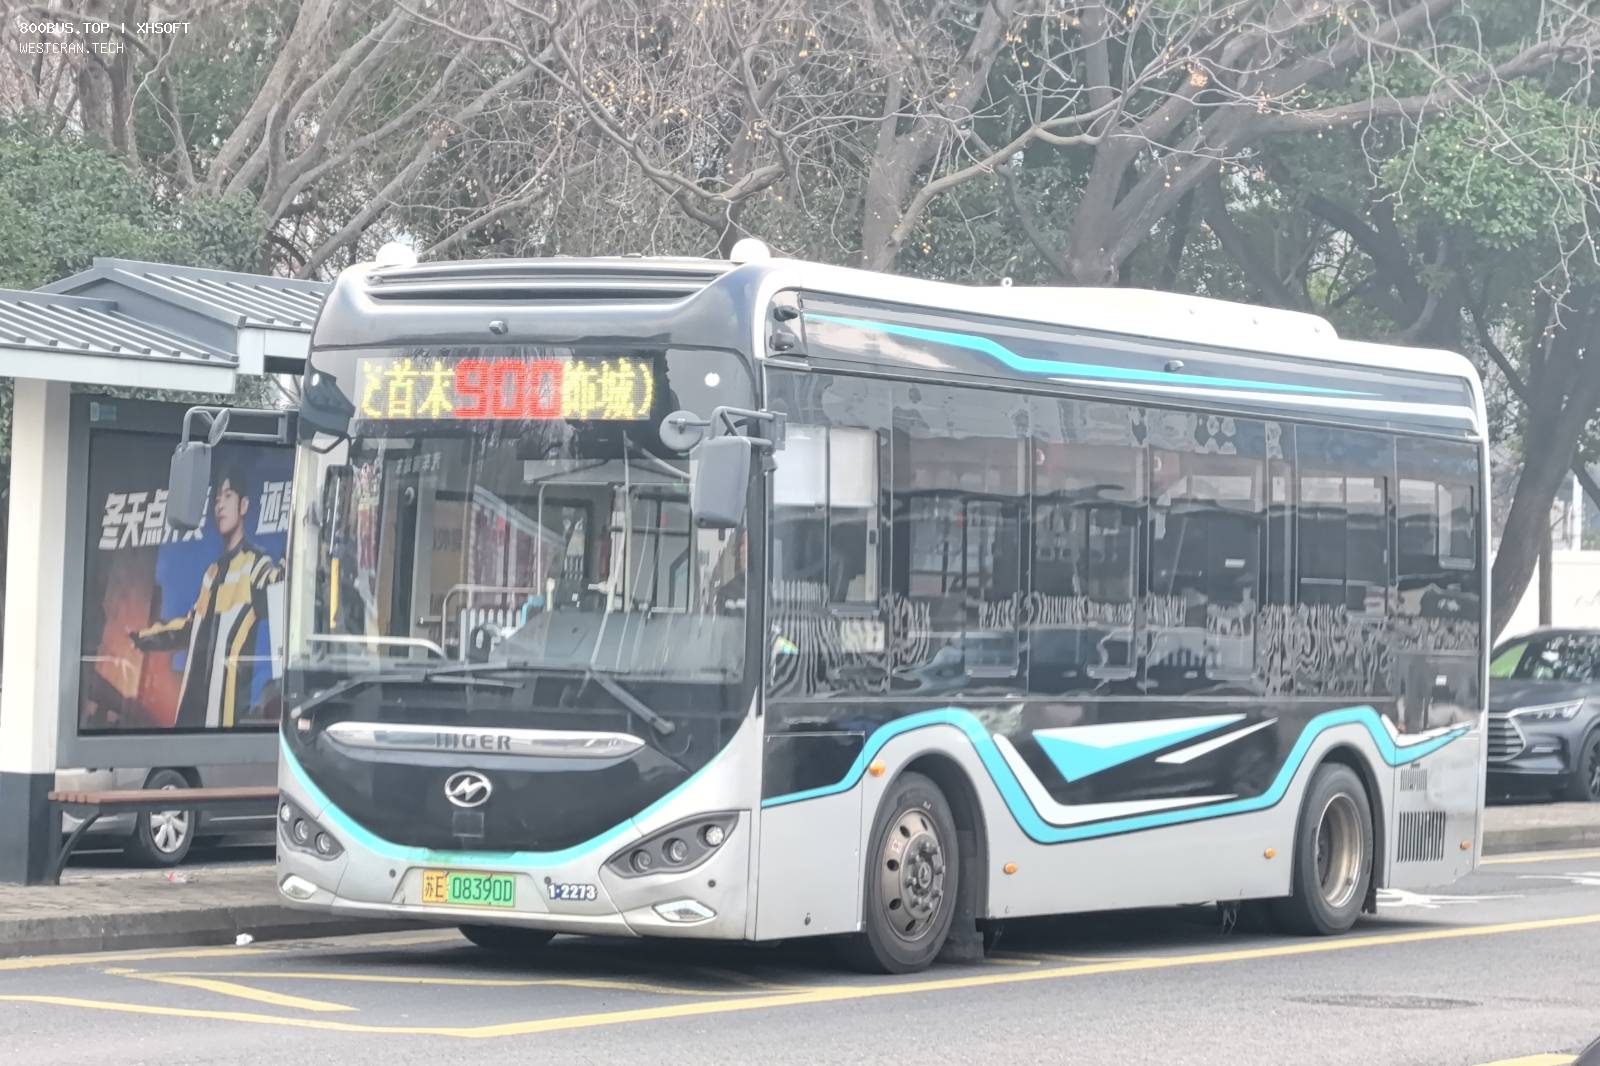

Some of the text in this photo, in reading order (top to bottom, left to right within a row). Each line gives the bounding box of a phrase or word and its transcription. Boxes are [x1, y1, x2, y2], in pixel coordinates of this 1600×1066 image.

[453, 358, 563, 418] 900
[435, 732, 511, 750] HIGER
[424, 875, 513, 902] 苏E 08390D
